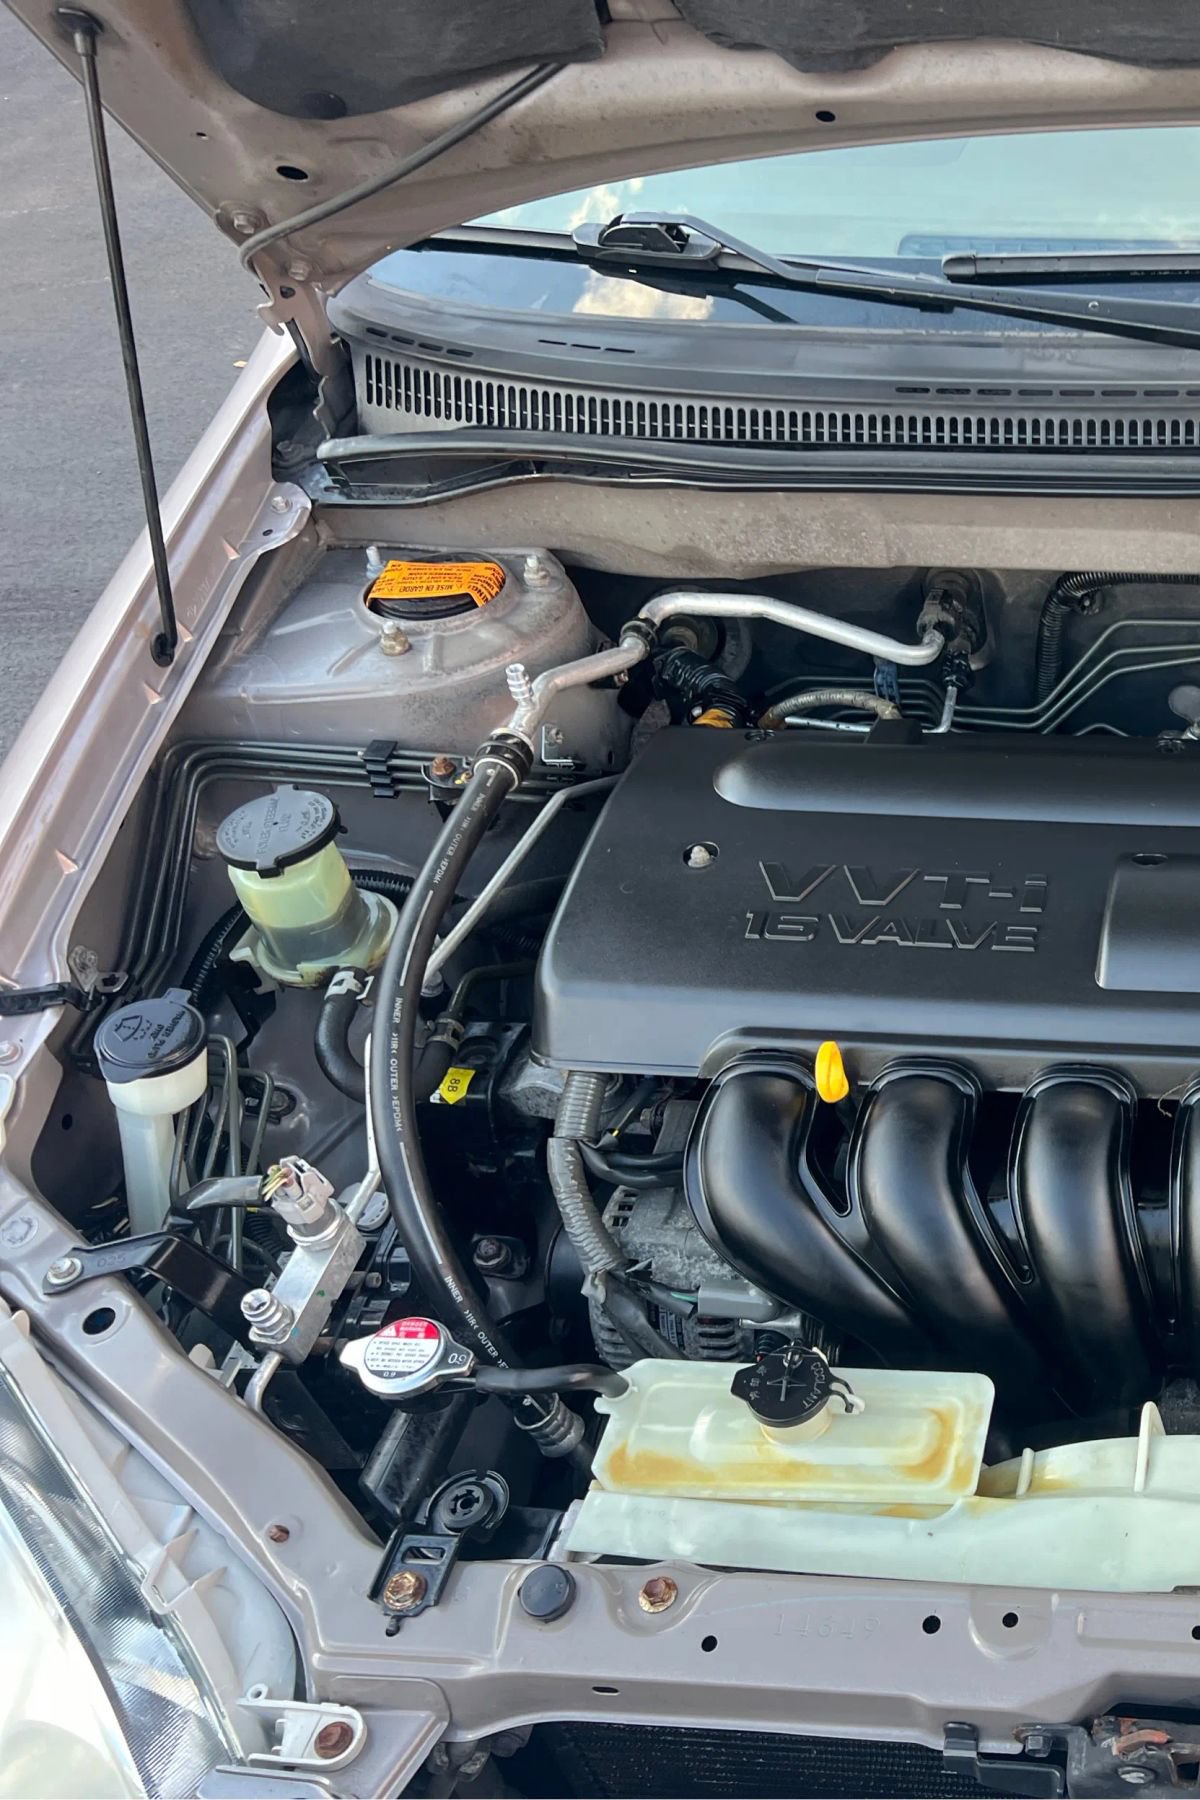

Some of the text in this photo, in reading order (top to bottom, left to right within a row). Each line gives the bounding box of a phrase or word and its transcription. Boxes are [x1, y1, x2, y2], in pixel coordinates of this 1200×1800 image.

[745, 910, 1039, 952] 16 VALVE
[392, 997, 403, 1024] INNER
[390, 1058, 399, 1092] OUTER
[444, 1275, 464, 1303] INNER
[477, 1331, 499, 1358] OUTER
[802, 1362, 826, 1409] COOLANT
